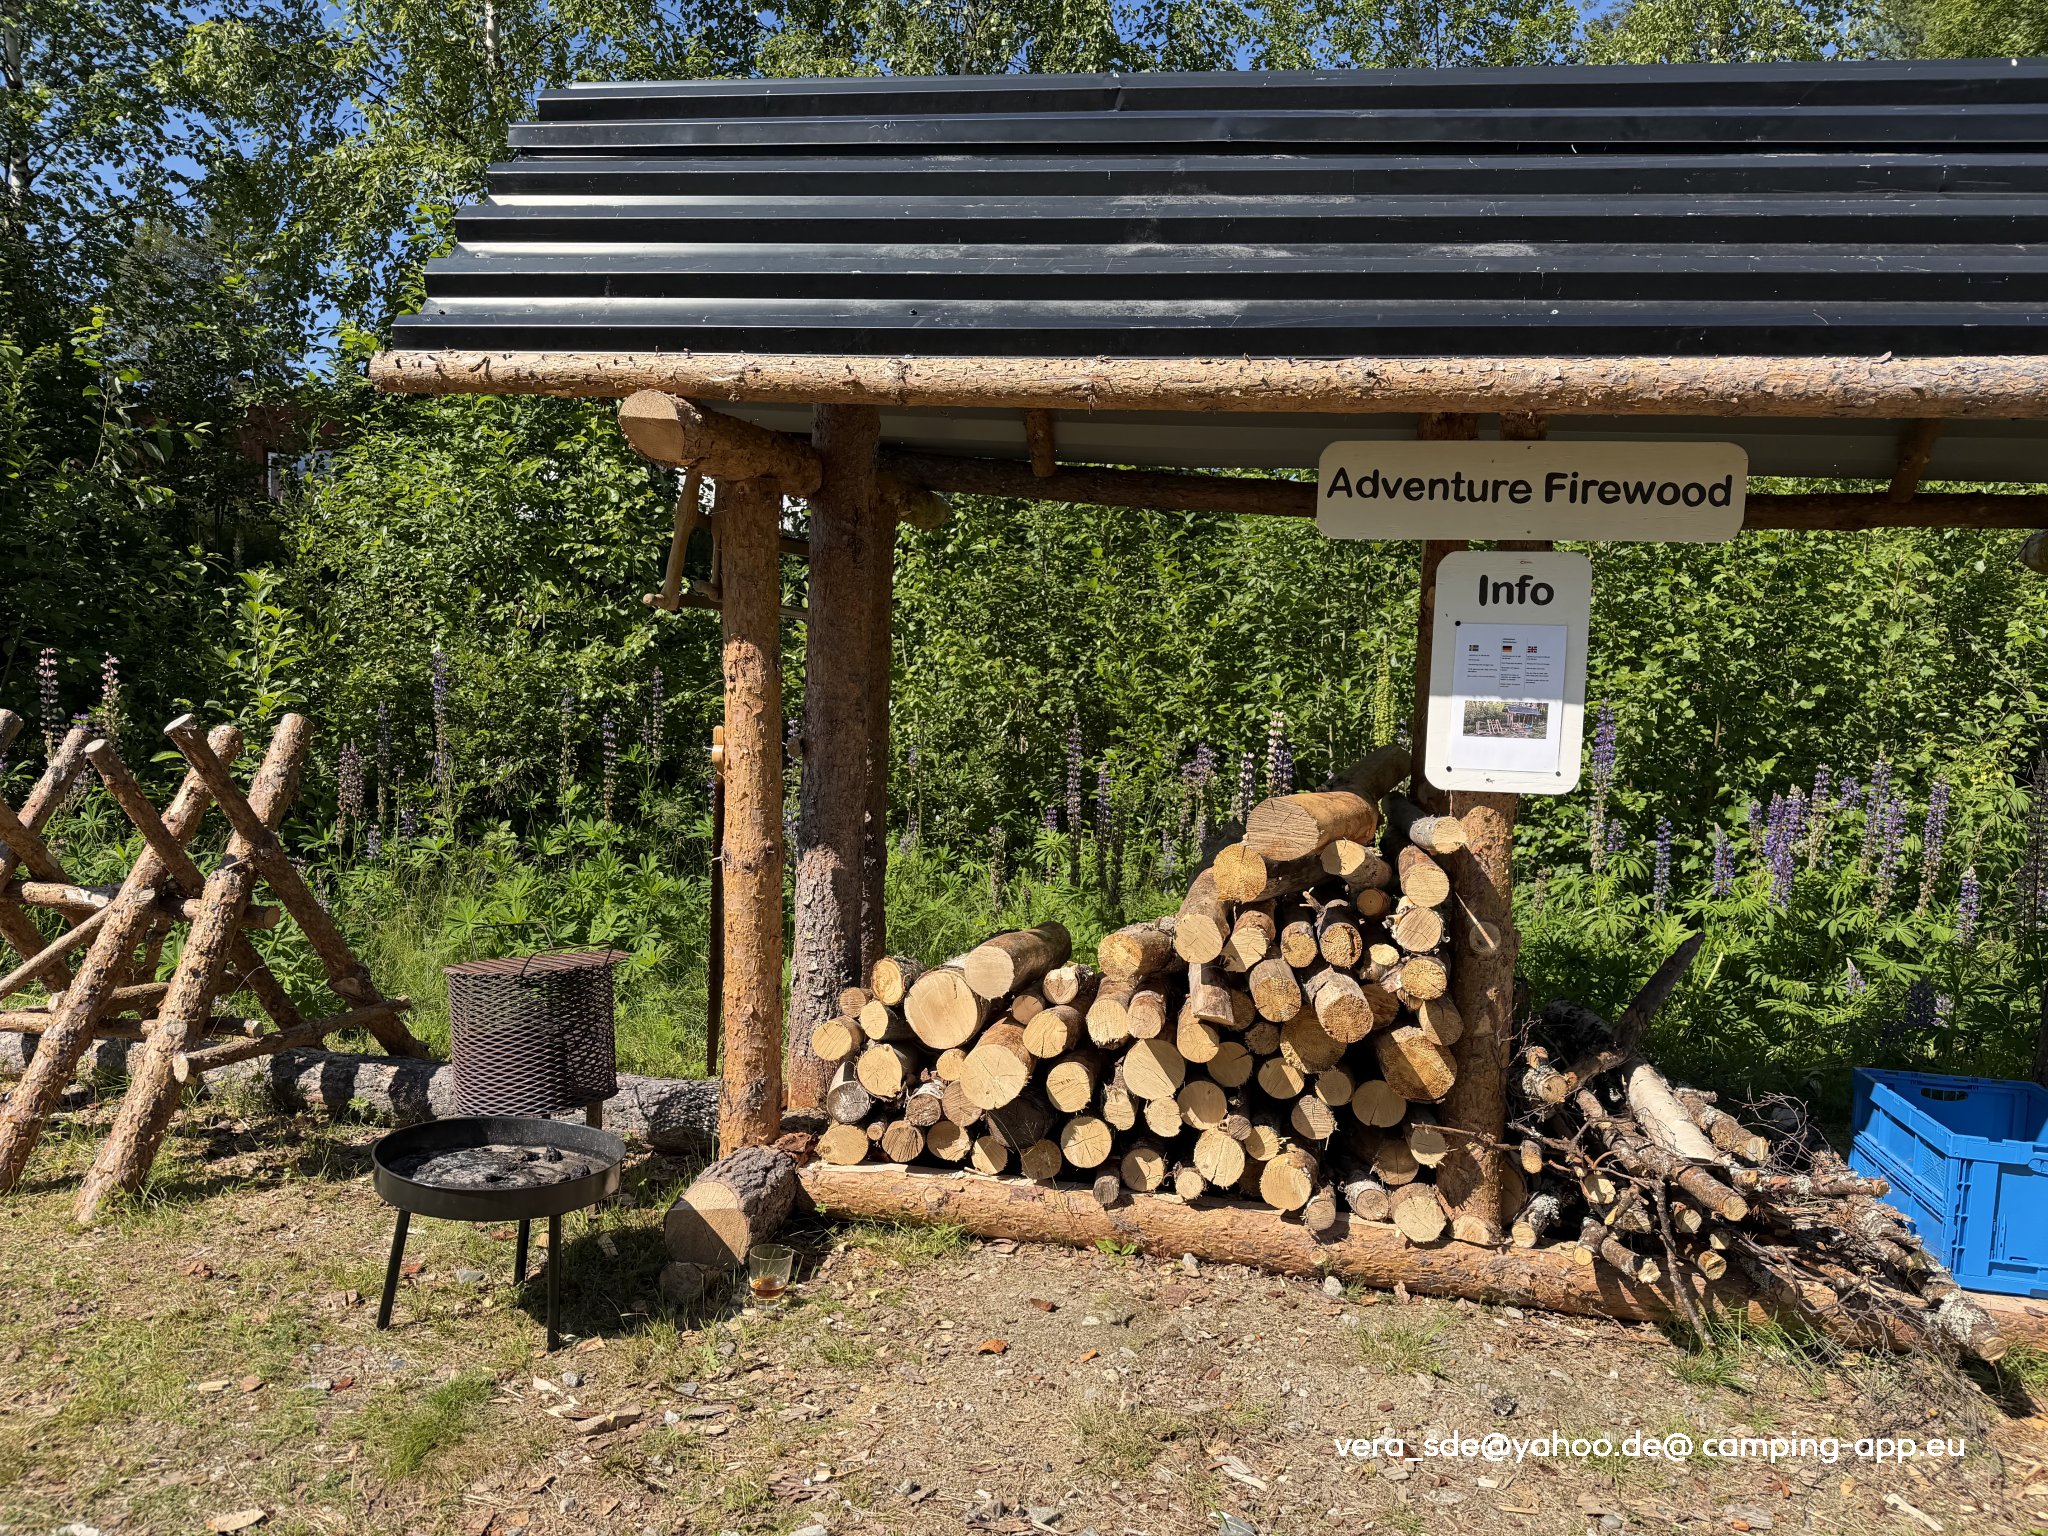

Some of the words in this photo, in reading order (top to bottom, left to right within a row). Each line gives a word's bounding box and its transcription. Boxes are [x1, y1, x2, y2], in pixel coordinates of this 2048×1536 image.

[1326, 466, 1533, 505] Adventure
[1544, 471, 1733, 508] Firewood
[1478, 574, 1555, 607] Info
